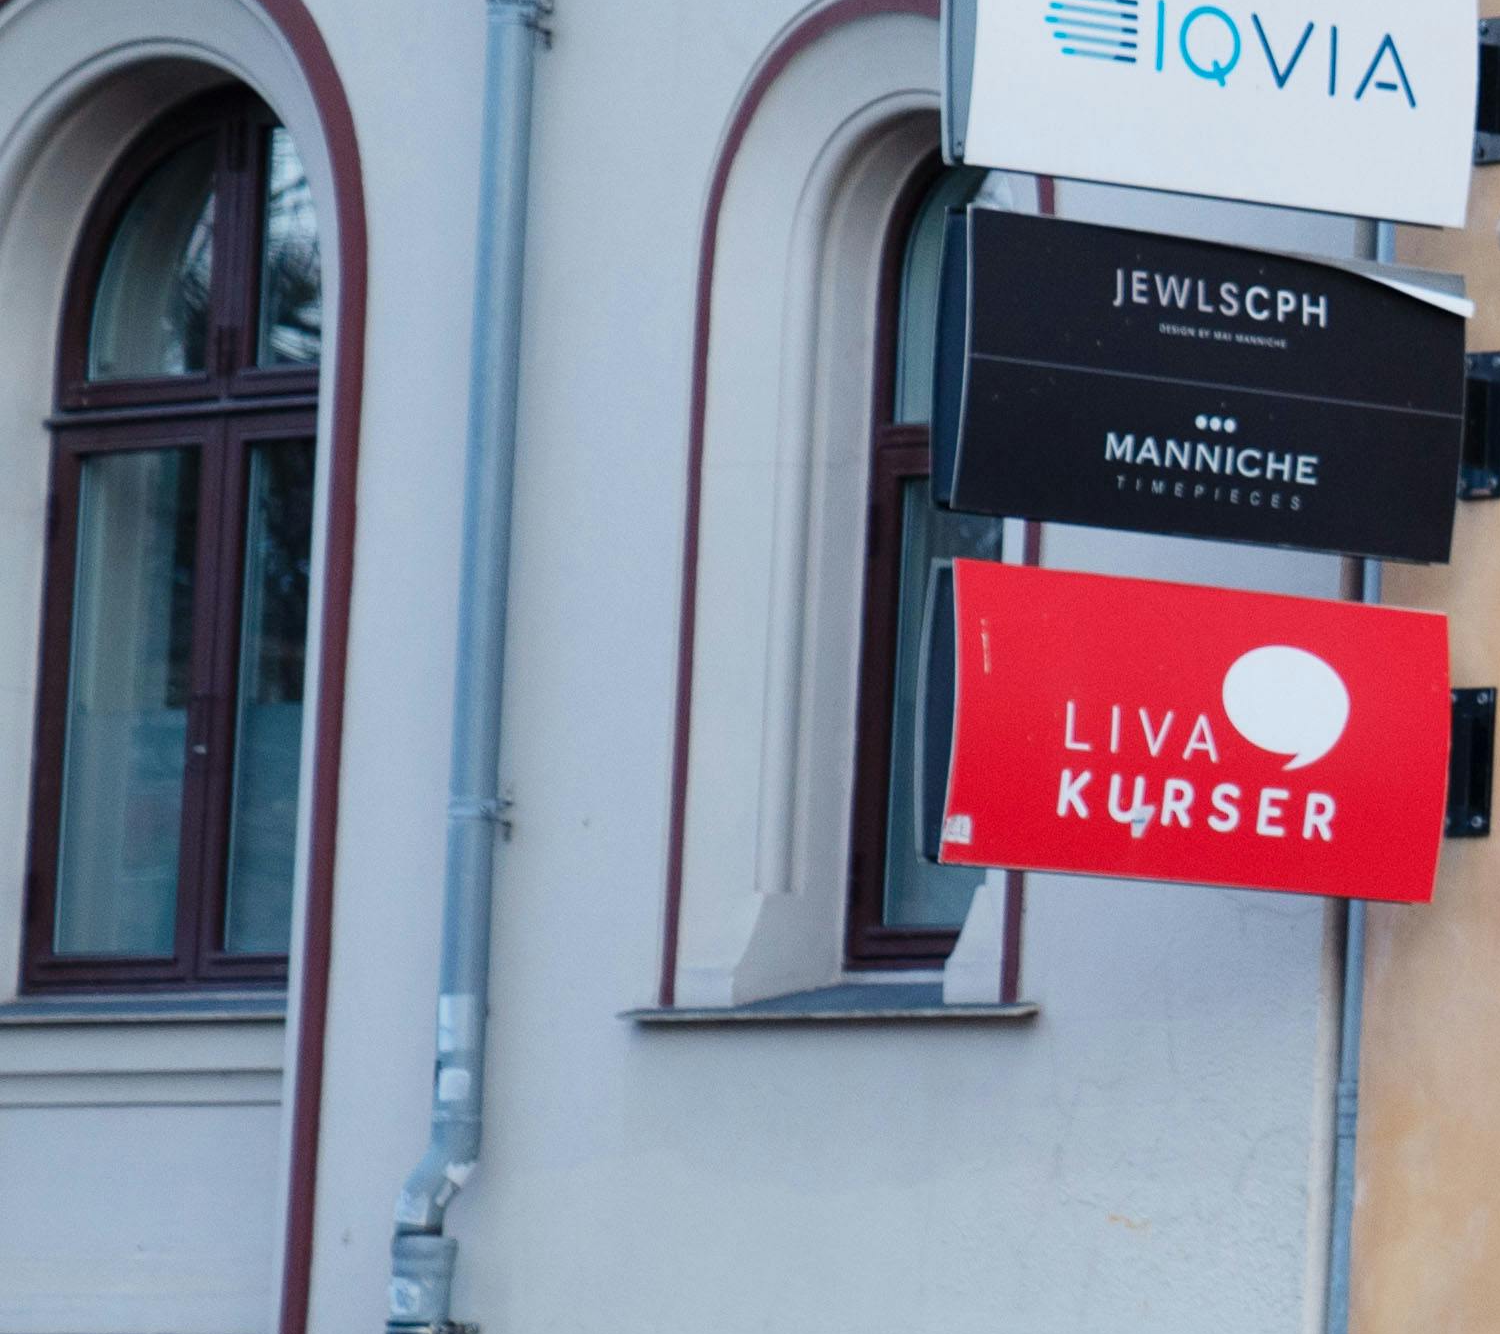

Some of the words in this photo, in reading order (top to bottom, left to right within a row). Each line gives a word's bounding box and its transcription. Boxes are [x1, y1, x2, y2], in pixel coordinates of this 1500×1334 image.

[1155, 0, 1418, 109] IQVIA
[1112, 267, 1329, 329] JEWLSCPH
[1159, 322, 1195, 338] DESIGN
[1198, 327, 1210, 339] BY
[1235, 332, 1288, 349] MANNICHE
[1103, 430, 1320, 486] MANNICHE
[1116, 474, 1303, 512] TIMEPIECES
[1064, 700, 1220, 764] LIVA
[1056, 768, 1338, 842] KURSER
